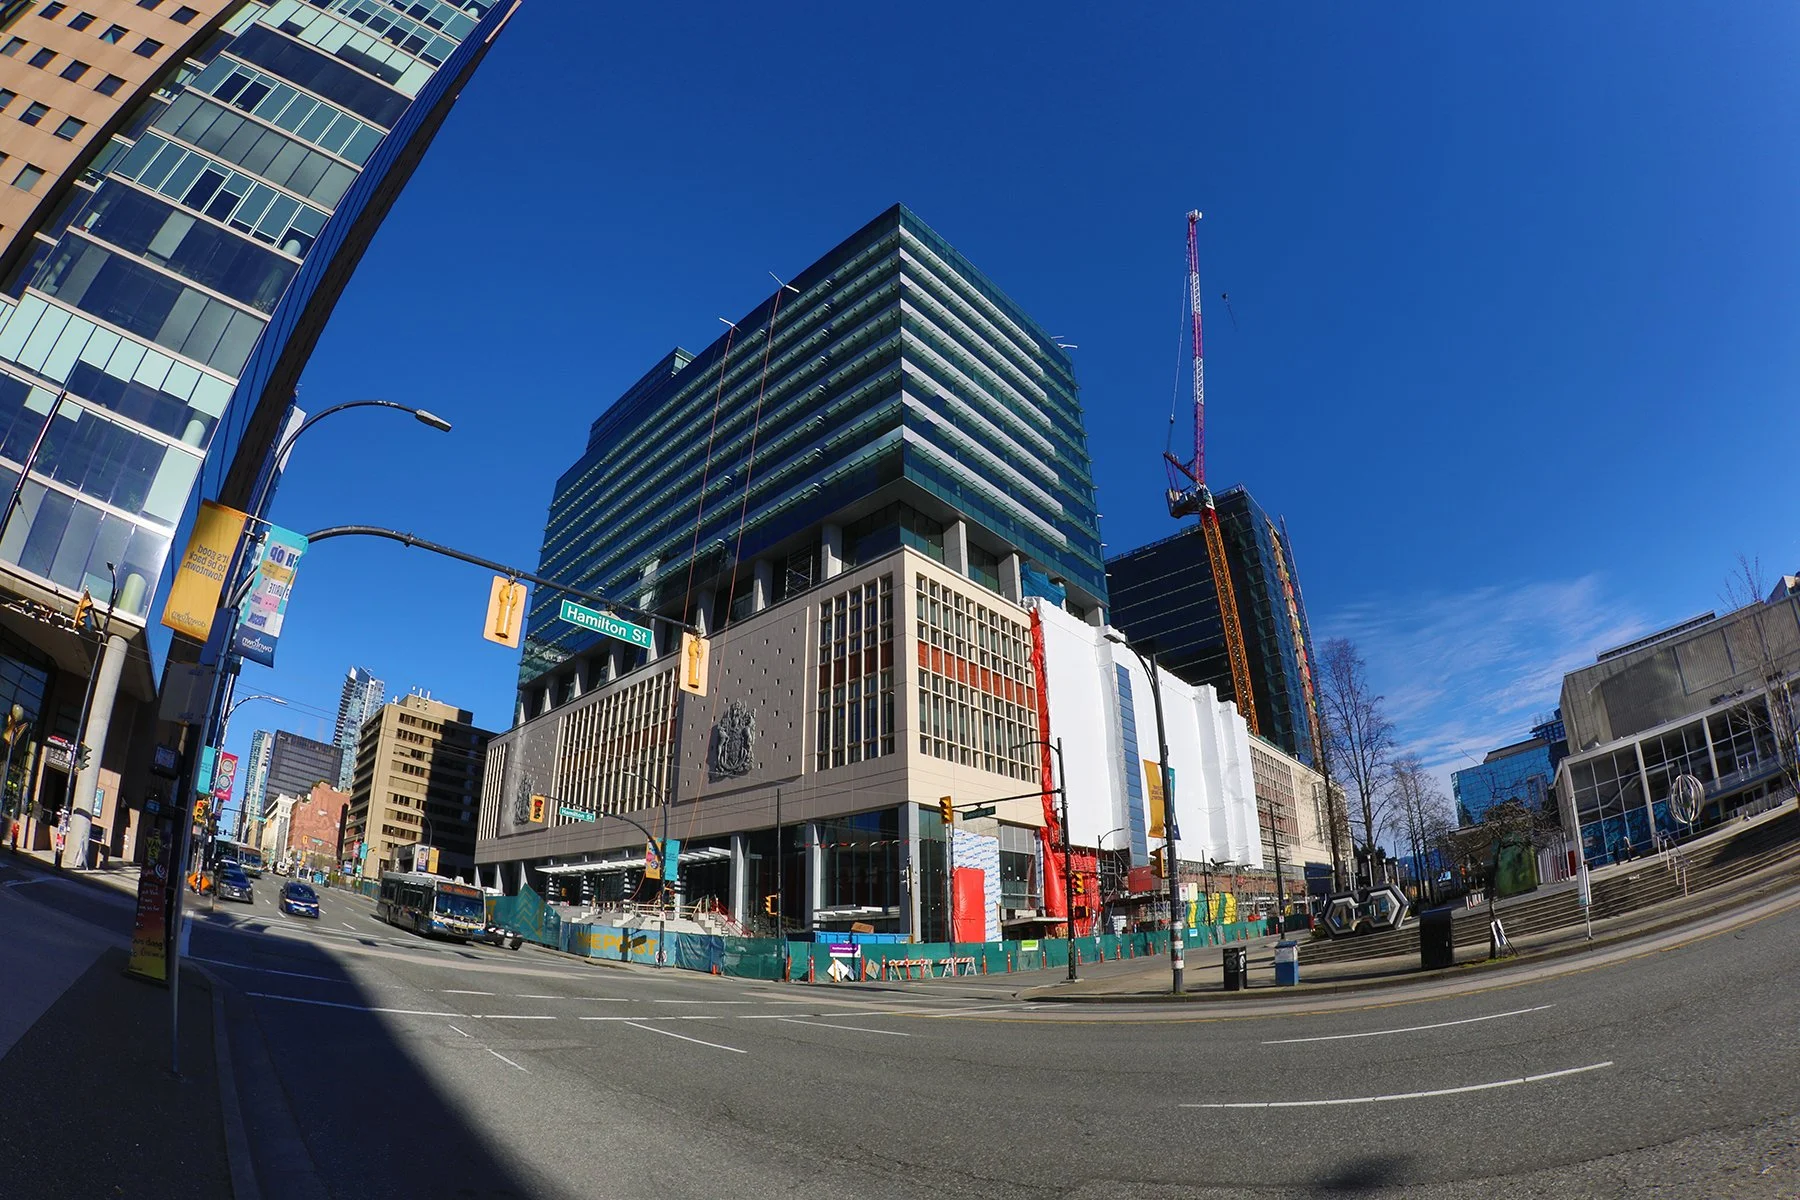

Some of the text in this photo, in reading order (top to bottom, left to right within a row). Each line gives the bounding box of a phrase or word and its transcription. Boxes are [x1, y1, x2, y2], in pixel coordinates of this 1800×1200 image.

[567, 605, 646, 644] Hamilton St
[561, 809, 593, 821] Hamilton St
